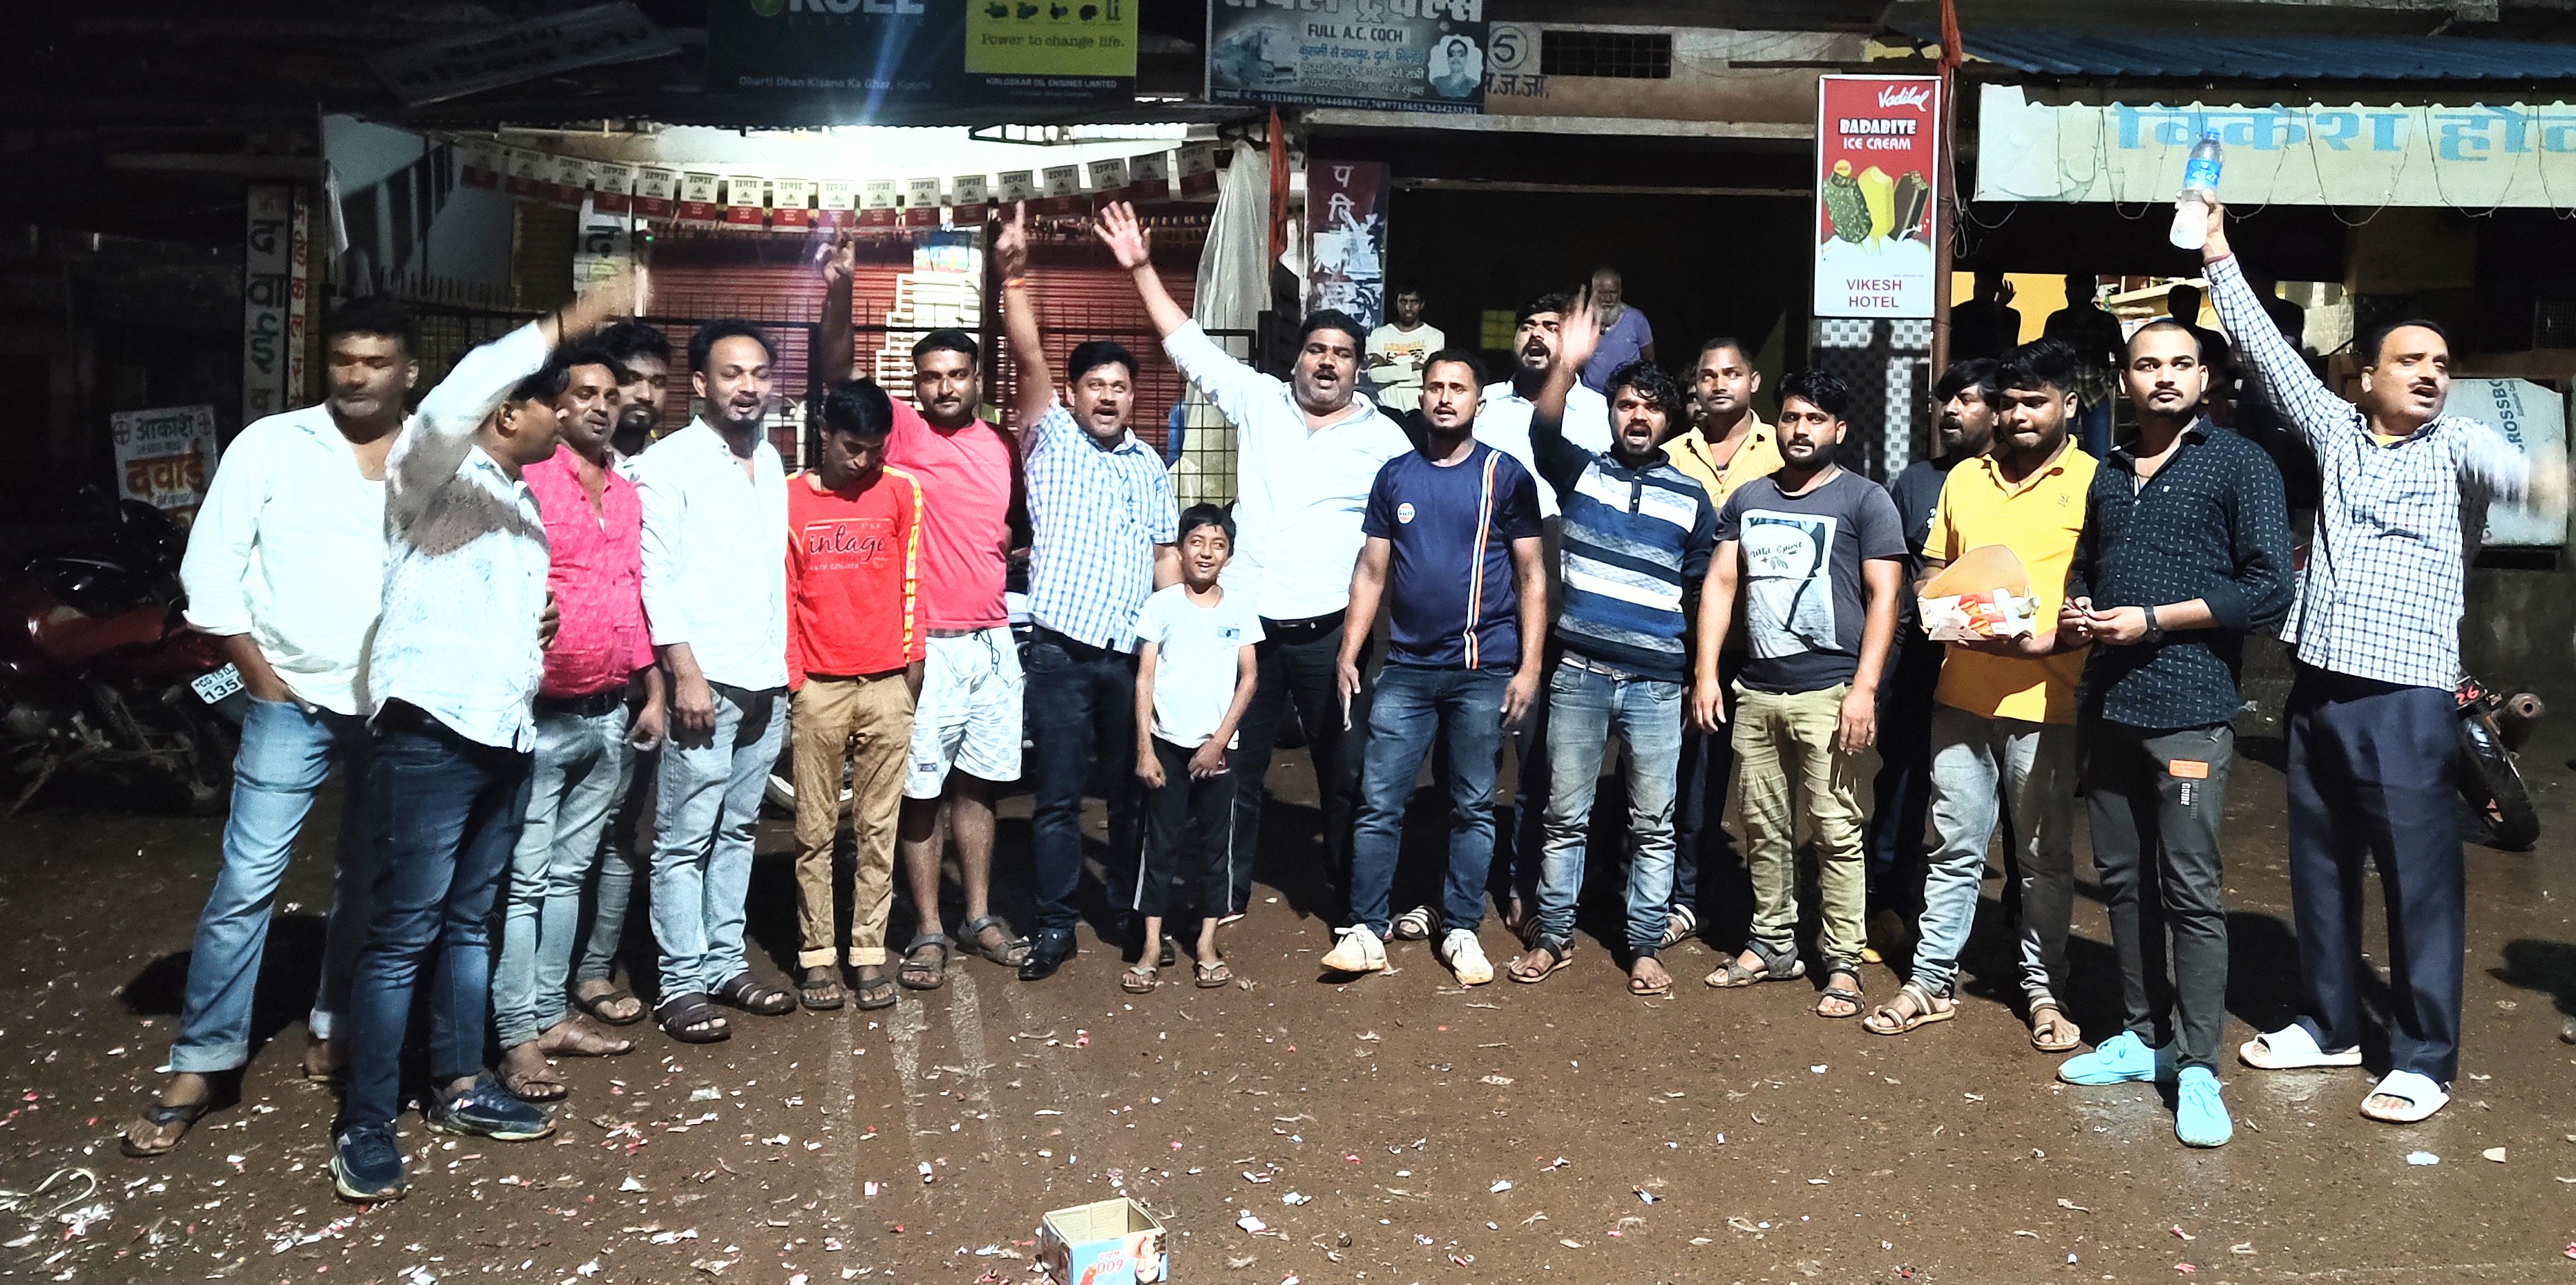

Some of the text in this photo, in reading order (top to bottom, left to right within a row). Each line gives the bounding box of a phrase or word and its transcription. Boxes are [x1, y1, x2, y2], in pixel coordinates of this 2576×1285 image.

[982, 34, 1125, 48] Power to change life.
[1307, 23, 1403, 42] FULL A.C. COCH
[1492, 34, 1518, 63] 5
[1878, 85, 1929, 112] Vadilal
[1839, 118, 1916, 135] BADABITE
[1843, 137, 1911, 150] ICE CREAM
[1846, 279, 1902, 291] VIKESH
[1849, 296, 1900, 308] HOTEL
[135, 413, 193, 441] आकाश
[125, 437, 207, 498] दवाई
[198, 677, 212, 687] CG
[211, 671, 224, 680] 15
[204, 675, 242, 700] 135
[1096, 1259, 1123, 1274] 600
